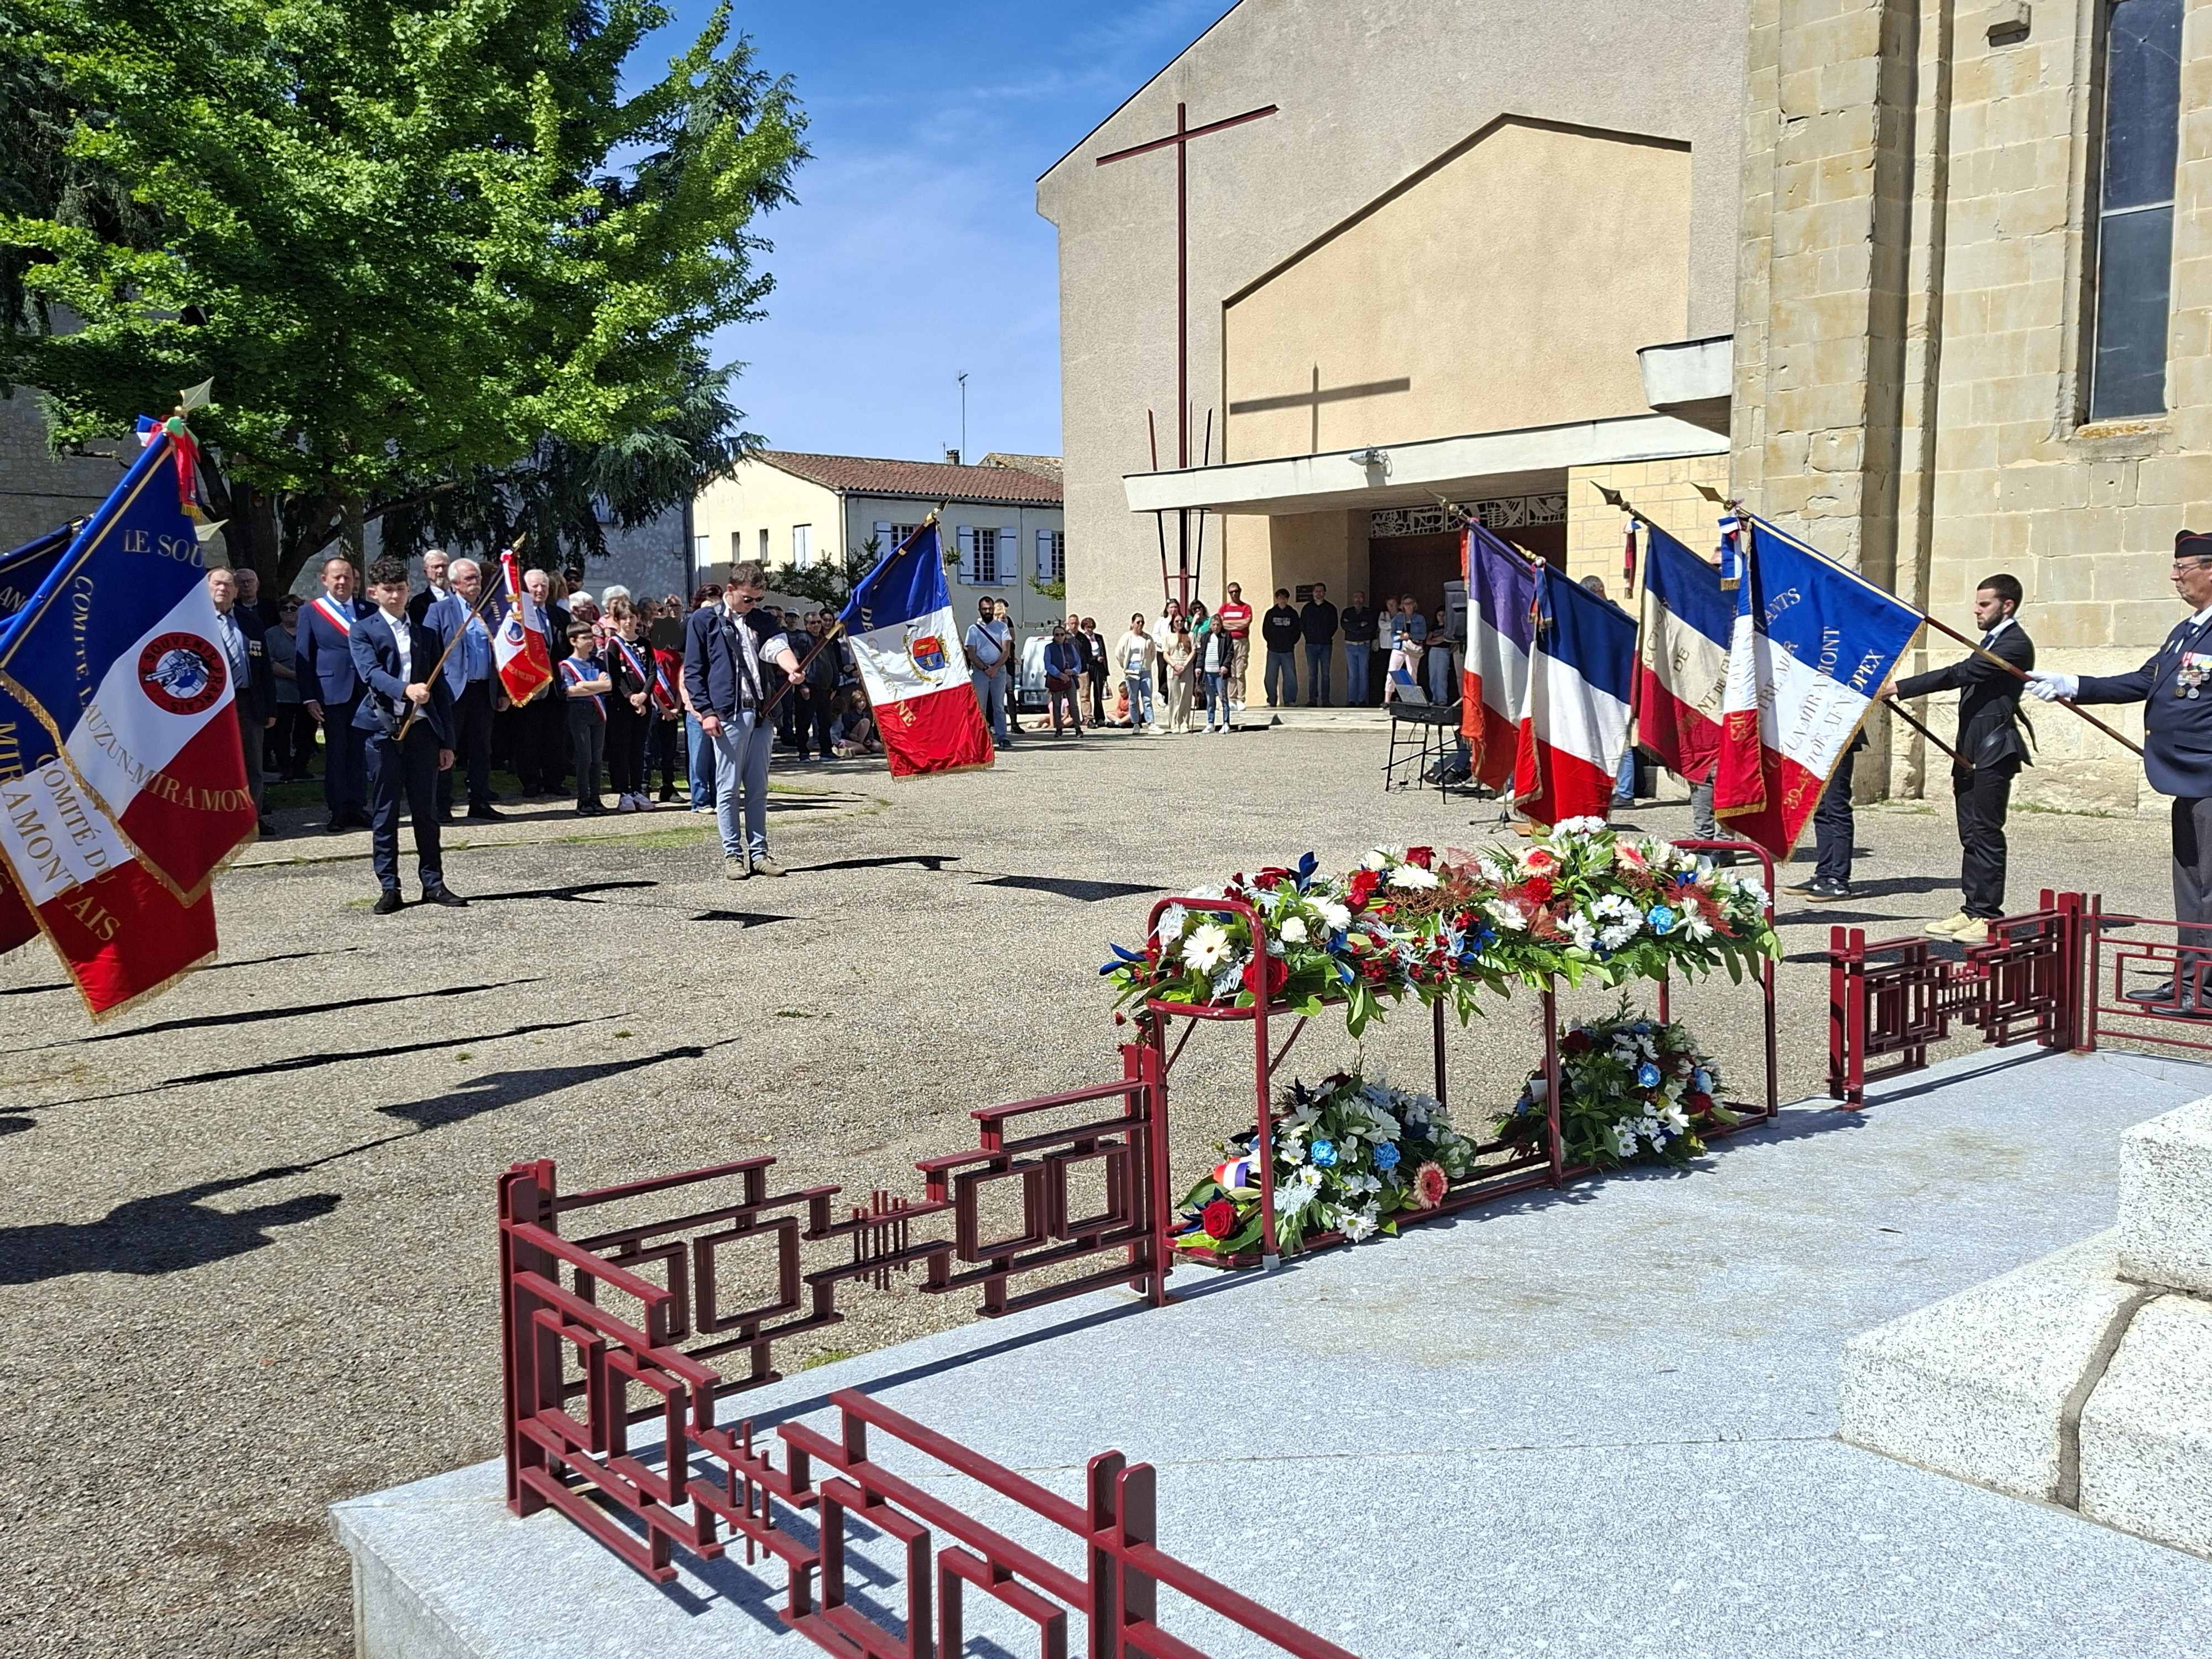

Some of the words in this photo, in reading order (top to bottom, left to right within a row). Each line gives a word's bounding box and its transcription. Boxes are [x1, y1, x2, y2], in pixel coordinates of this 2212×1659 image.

[123, 529, 150, 553] LE
[861, 607, 875, 632] DE
[144, 635, 218, 662] SOUVENIR
[1673, 648, 1690, 674] DE
[867, 637, 917, 727] GUYENNE
[1847, 649, 1885, 693] OPEX
[35, 754, 102, 847] COMITÉ
[83, 847, 117, 884] DU
